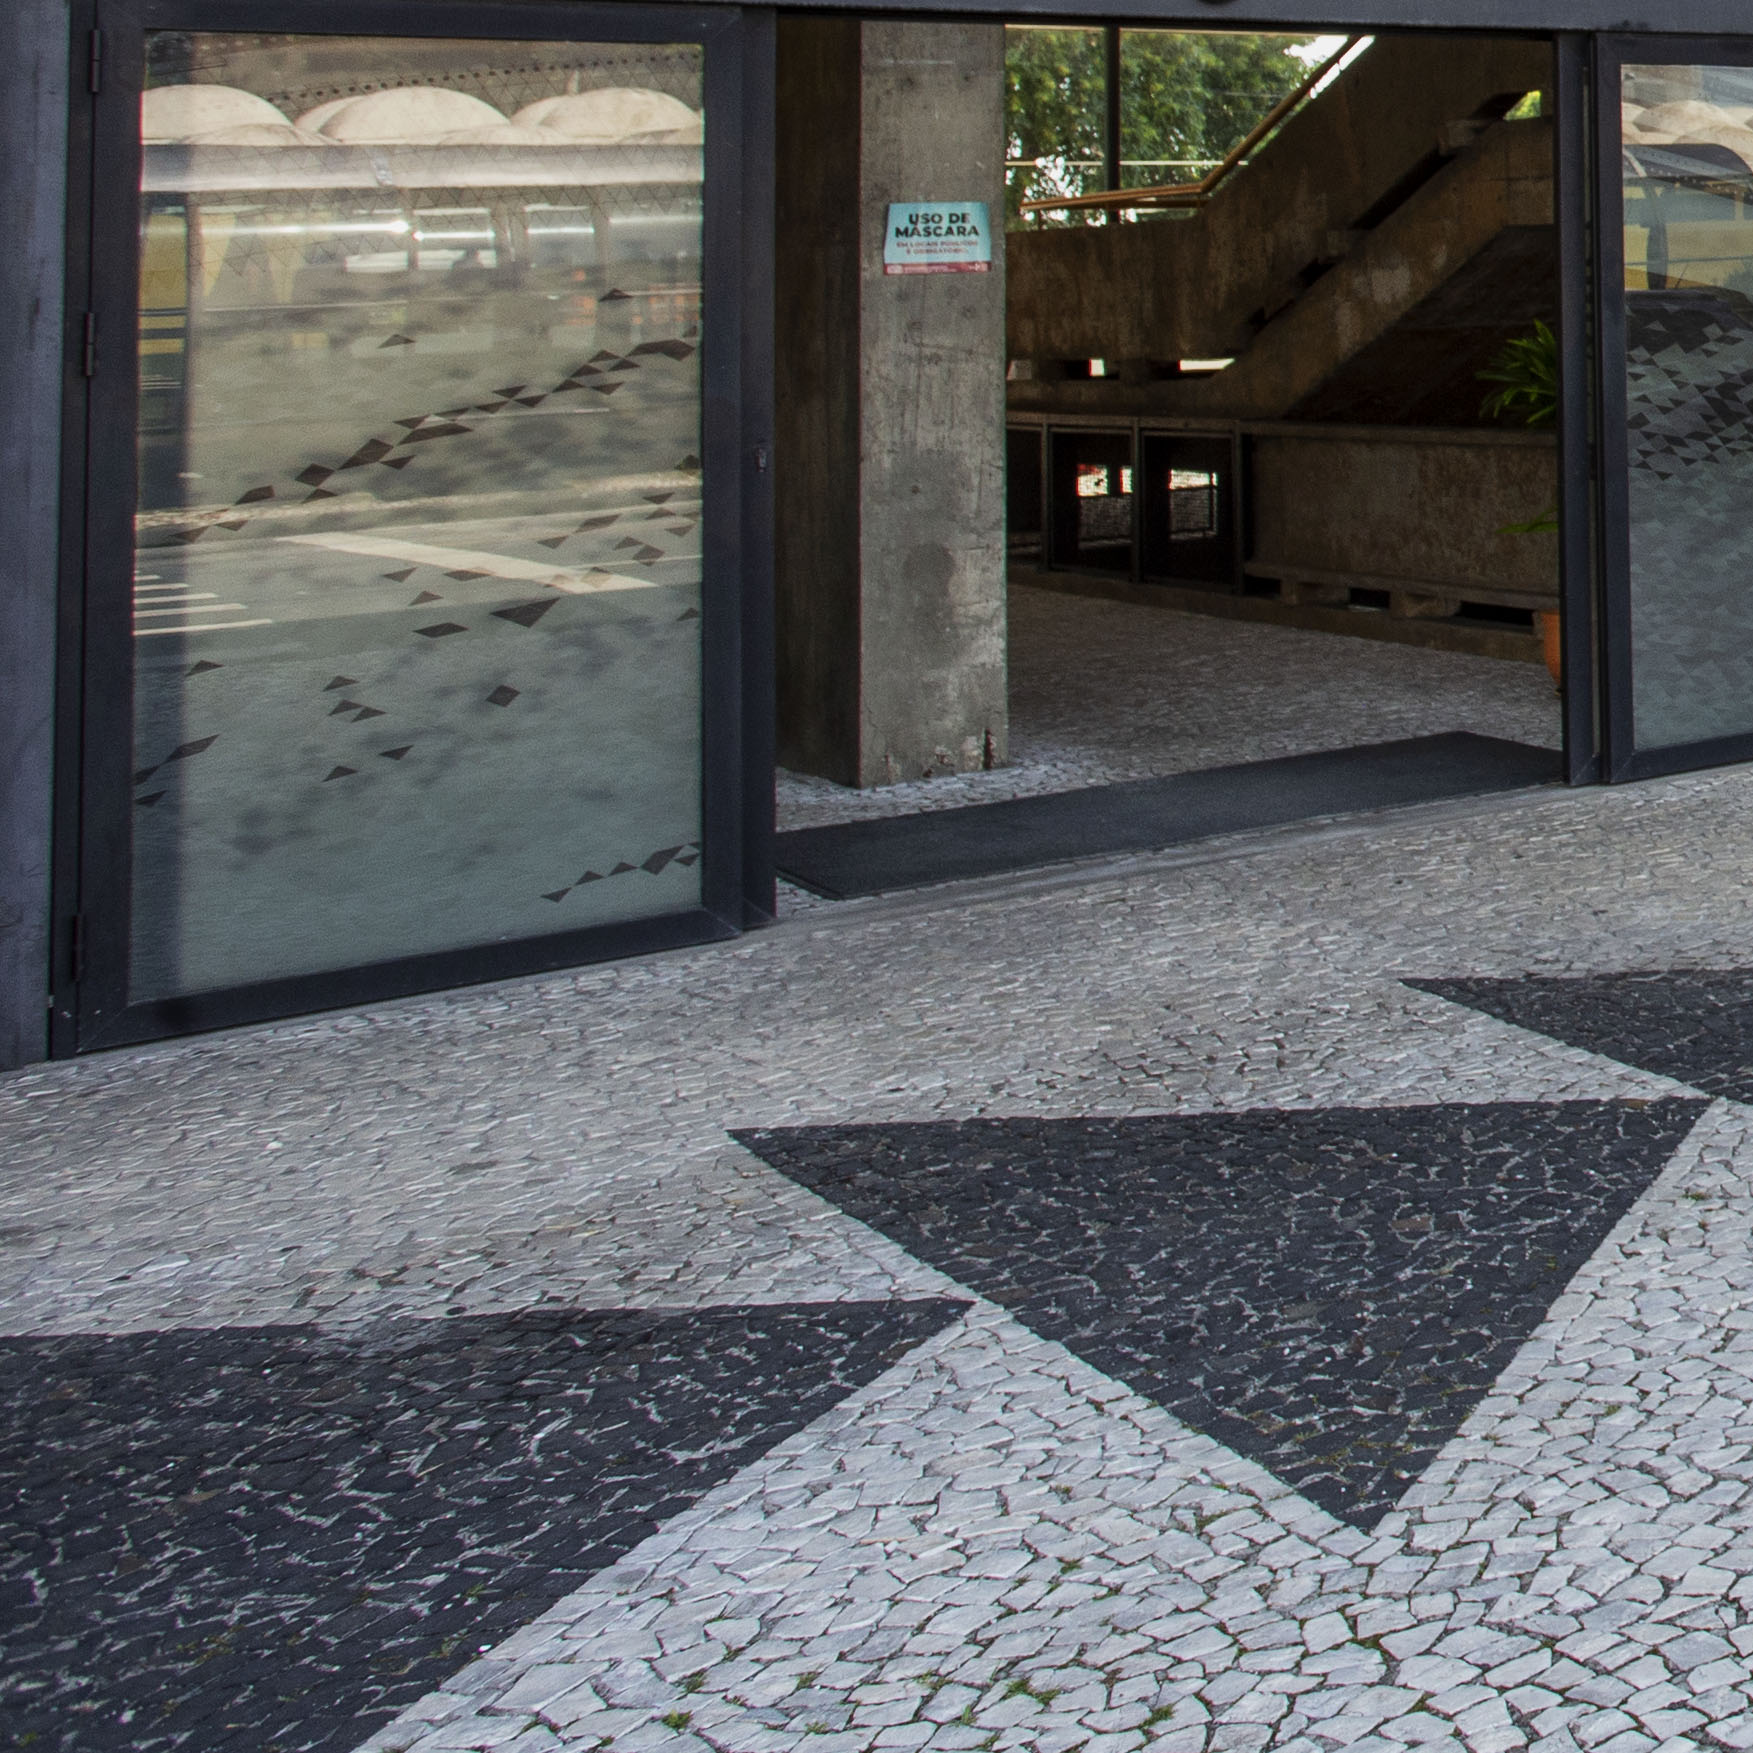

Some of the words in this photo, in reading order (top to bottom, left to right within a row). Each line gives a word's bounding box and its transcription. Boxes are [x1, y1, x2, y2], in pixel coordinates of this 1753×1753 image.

[909, 213, 943, 224] USO
[948, 212, 971, 224] DE
[895, 224, 979, 238] MÁSCARA
